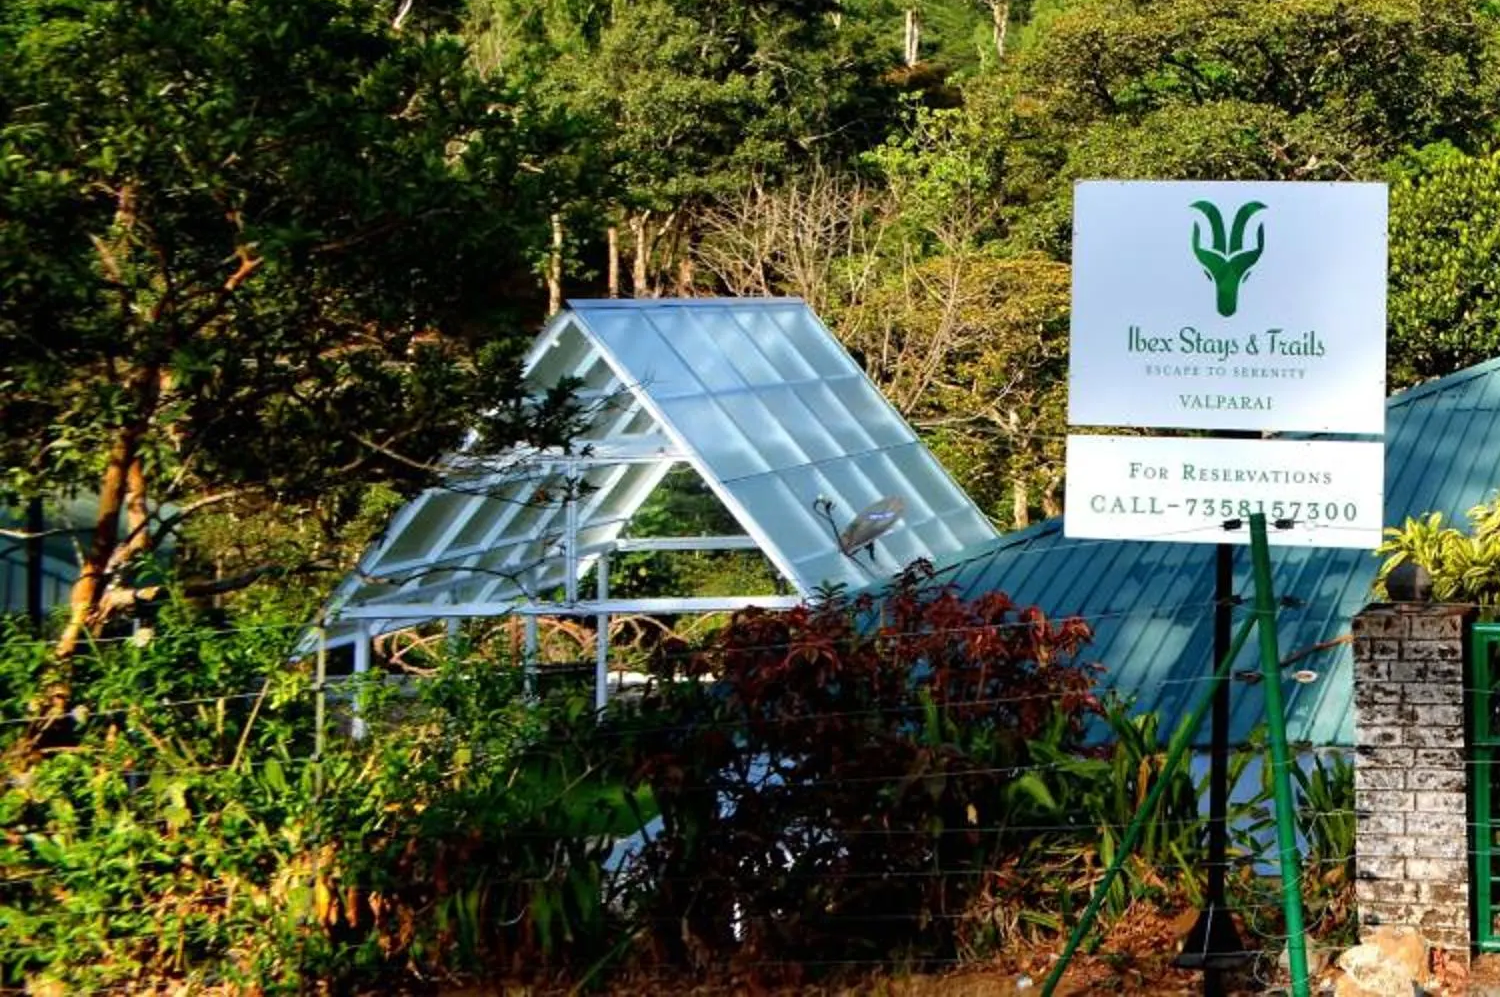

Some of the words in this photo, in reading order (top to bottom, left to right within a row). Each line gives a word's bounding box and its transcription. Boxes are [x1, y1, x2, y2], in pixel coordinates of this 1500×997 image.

[1128, 326, 1172, 353] Ibex
[1180, 327, 1240, 361] Stays
[1246, 334, 1259, 356] &
[1266, 328, 1325, 357] Trails
[1146, 365, 1199, 376] ESCAPE
[1208, 366, 1227, 377] TO
[1234, 367, 1306, 379] SERENITY
[1179, 394, 1272, 411] VALPARAI
